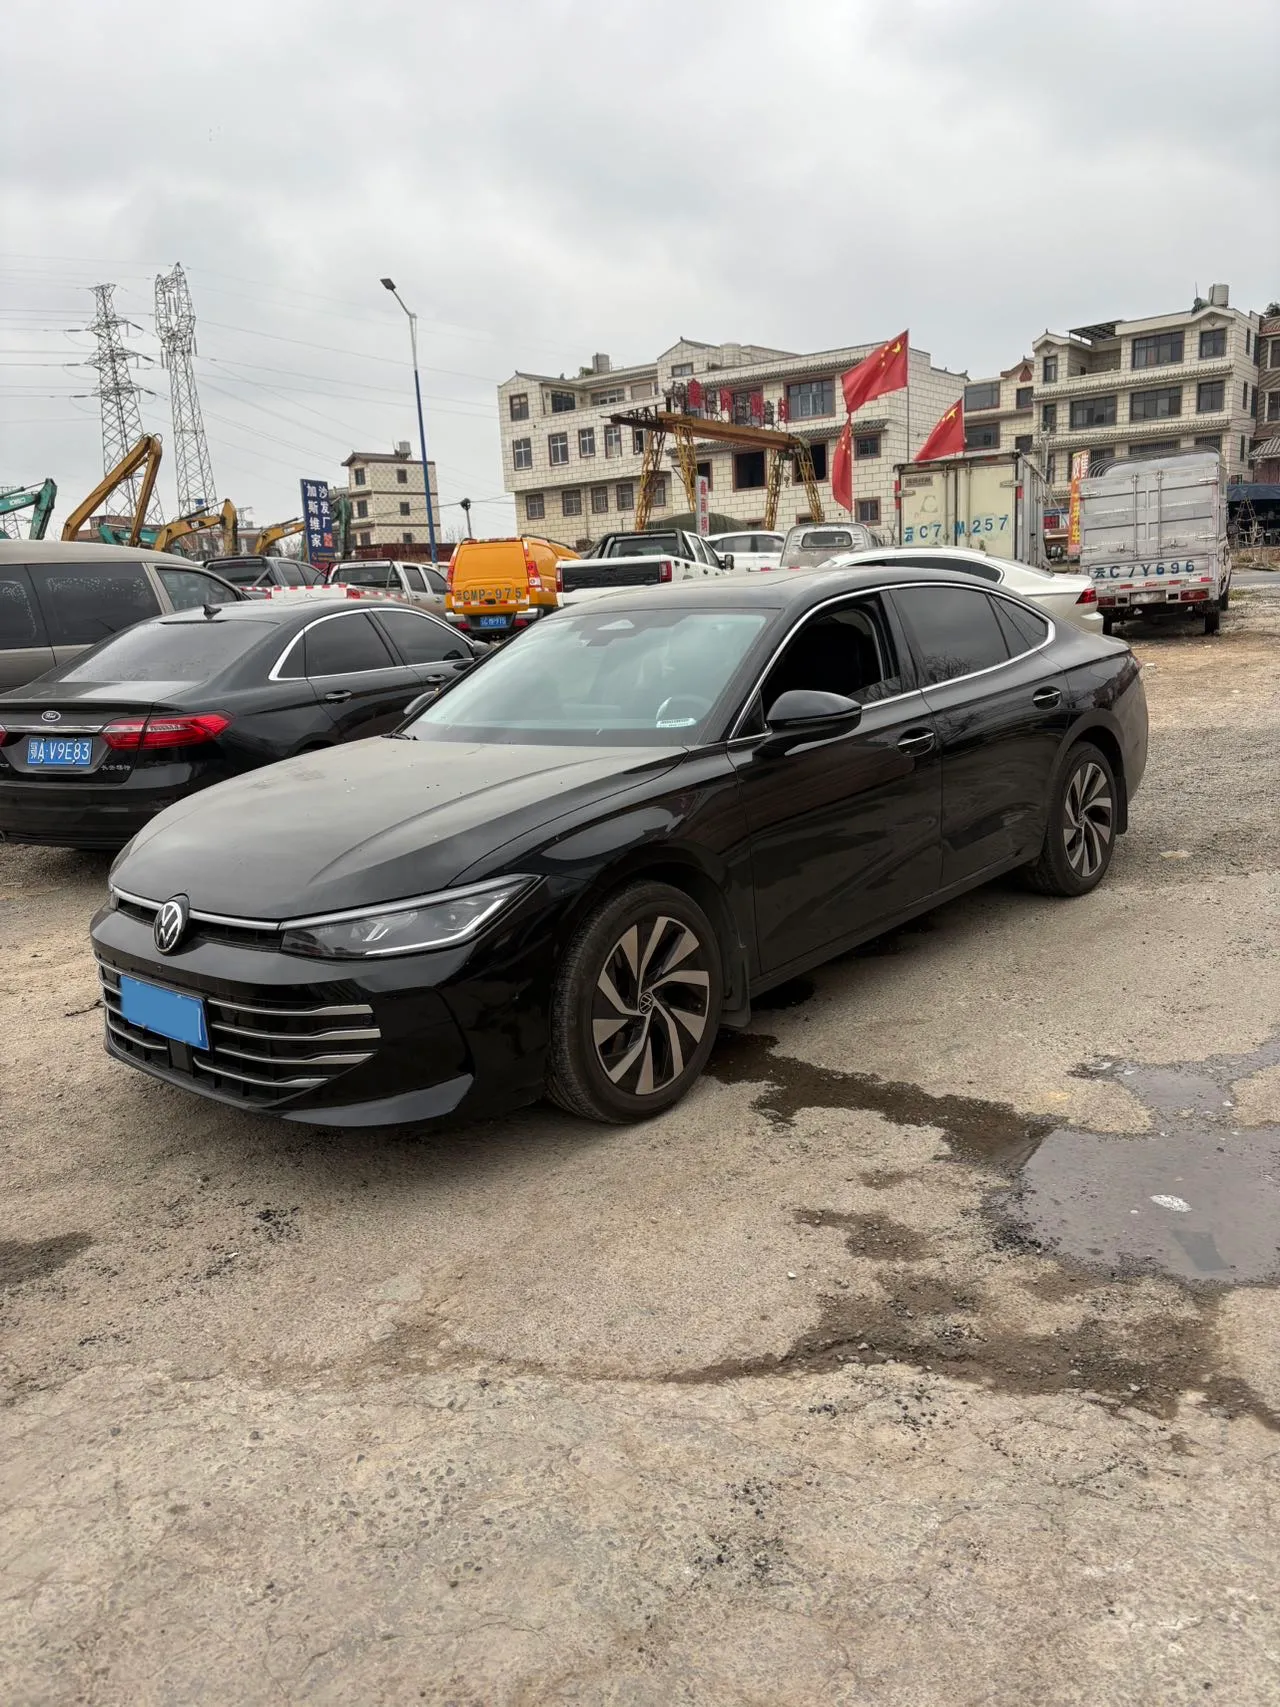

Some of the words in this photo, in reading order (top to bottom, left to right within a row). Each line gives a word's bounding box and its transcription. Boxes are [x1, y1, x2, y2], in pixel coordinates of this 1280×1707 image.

[306, 483, 322, 548] 加斯维家
[318, 485, 331, 529] 沙发厂
[1094, 560, 1195, 579] 云C7Y696
